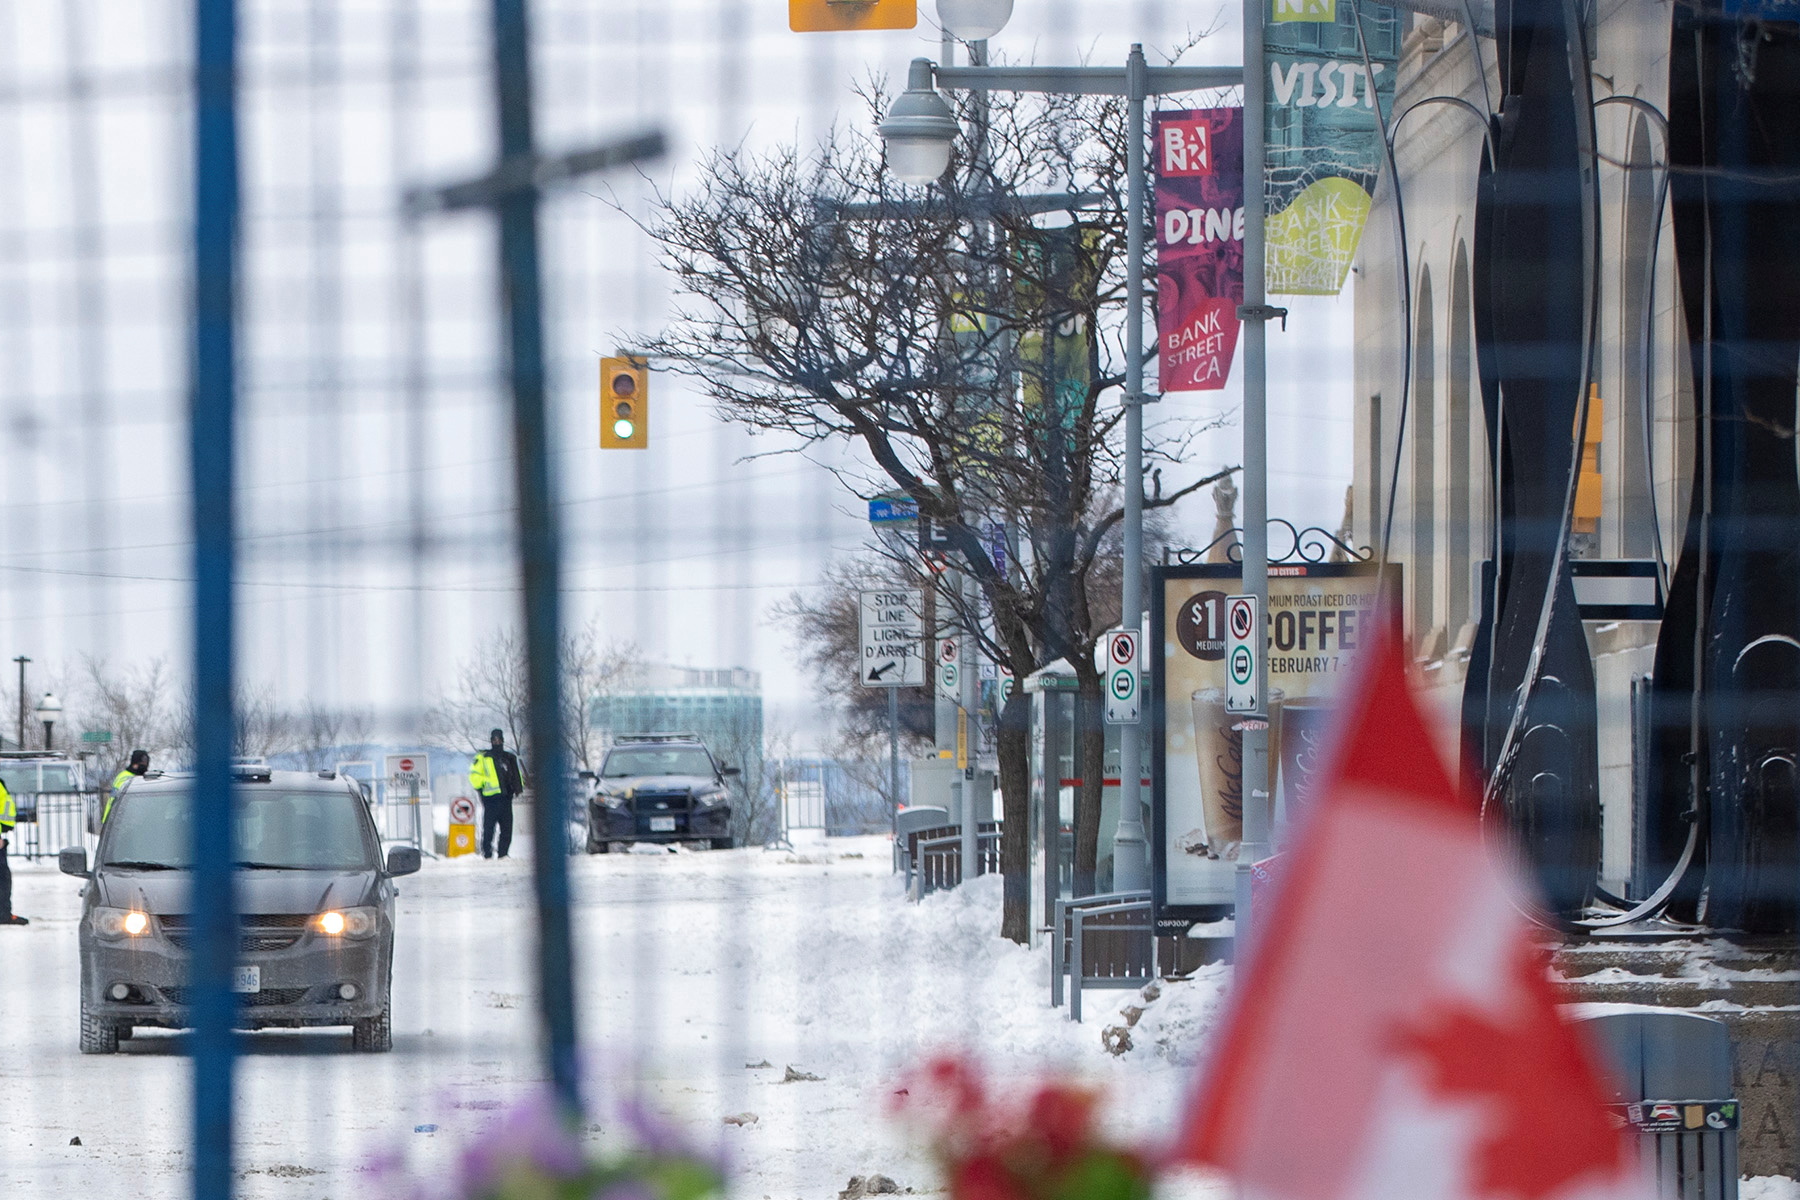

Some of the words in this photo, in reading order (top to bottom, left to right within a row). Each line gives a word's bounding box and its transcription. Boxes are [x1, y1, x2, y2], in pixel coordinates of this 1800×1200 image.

[1271, 61, 1385, 108] VISIT
[1168, 308, 1221, 350] BANK
[1167, 332, 1225, 368] STREET
[1188, 356, 1221, 384] .CA
[1279, 567, 1300, 576] CITIES
[875, 593, 908, 606] STOP
[1269, 594, 1292, 608] MIUM
[1294, 594, 1322, 608] ROAST
[1324, 594, 1344, 607] ICED
[878, 609, 906, 622] LINE
[1191, 599, 1216, 639] $1
[1267, 610, 1372, 652] OFFE
[240, 973, 258, 986] 946
